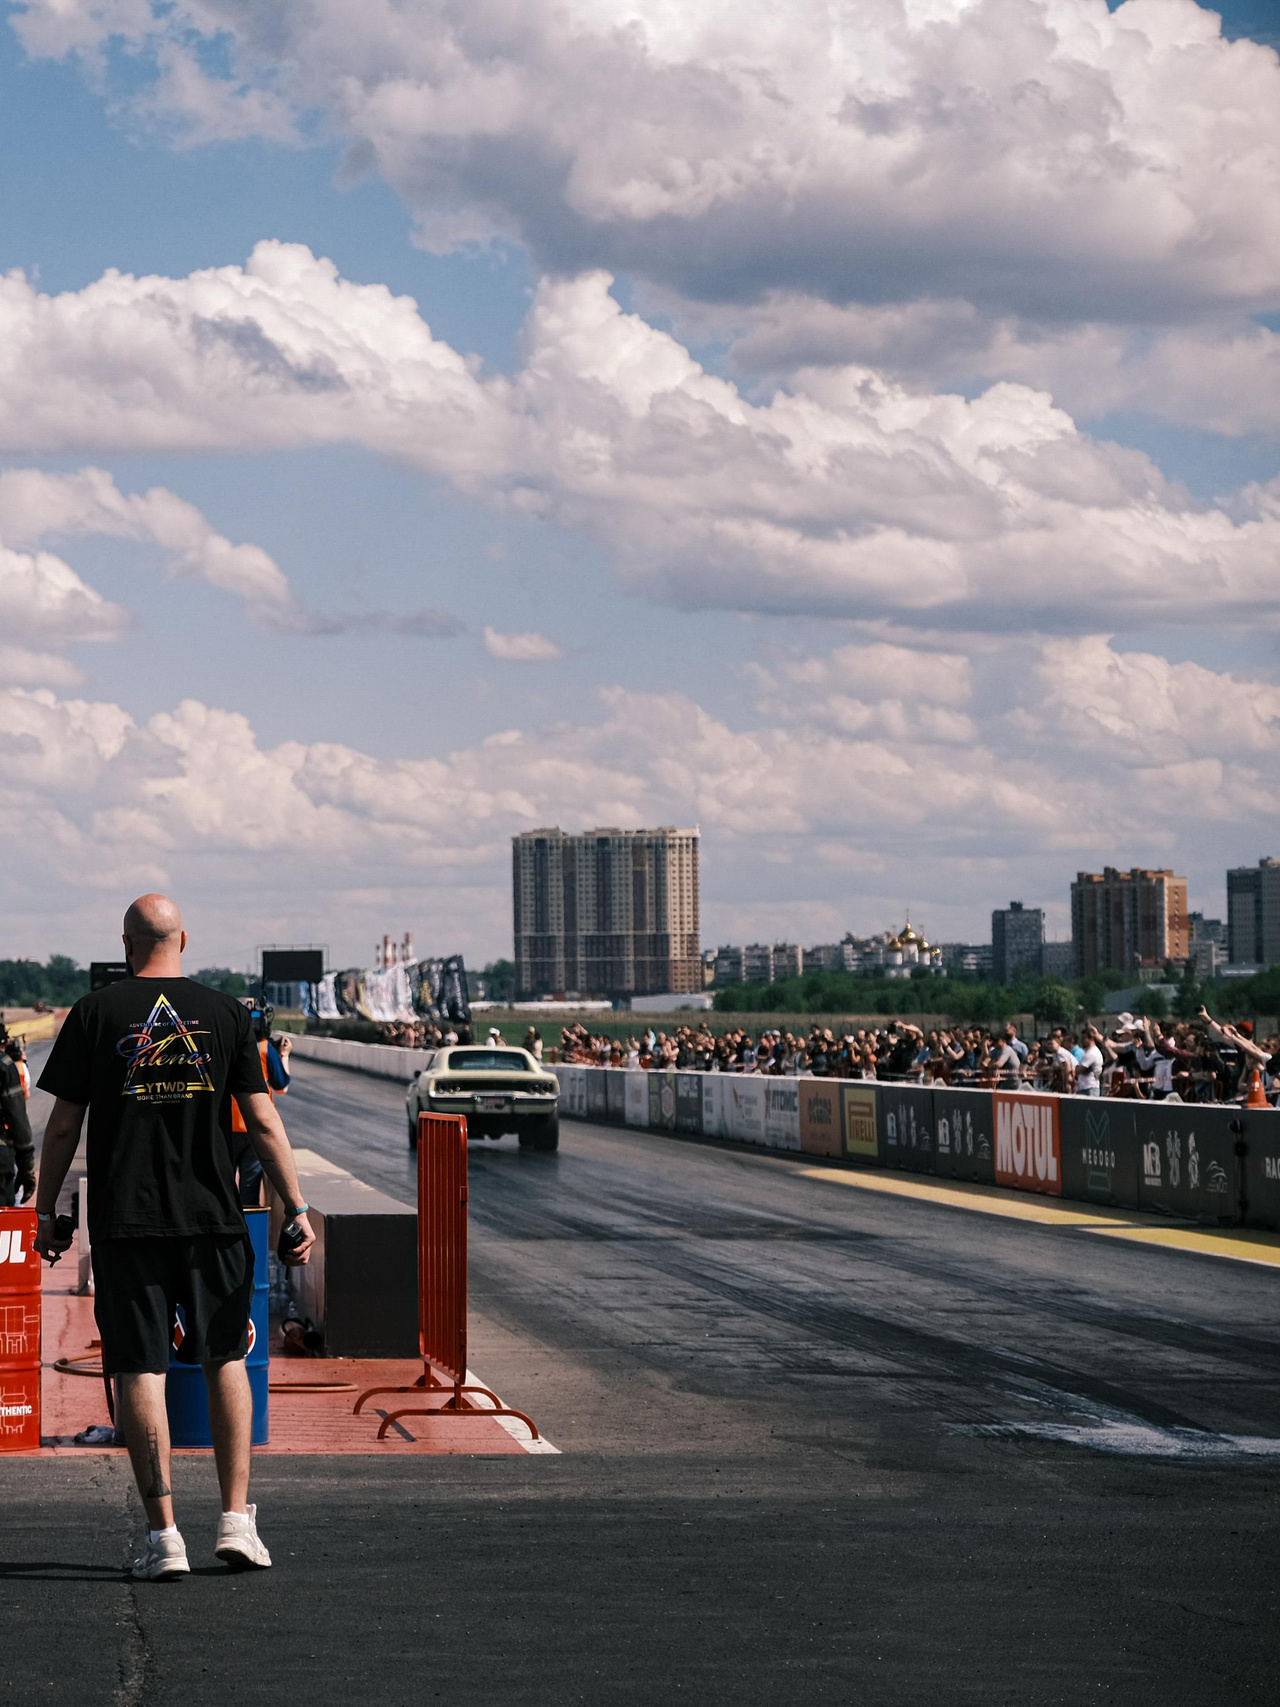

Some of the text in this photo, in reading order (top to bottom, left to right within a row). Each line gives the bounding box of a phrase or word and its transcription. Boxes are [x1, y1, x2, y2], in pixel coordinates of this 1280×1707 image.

[116, 1031, 212, 1068] Silence
[145, 1081, 186, 1093] YTWD
[848, 1102, 875, 1143] PIRELLI
[997, 1101, 1057, 1181] MOTUL
[1082, 1148, 1116, 1168] MEGOGO
